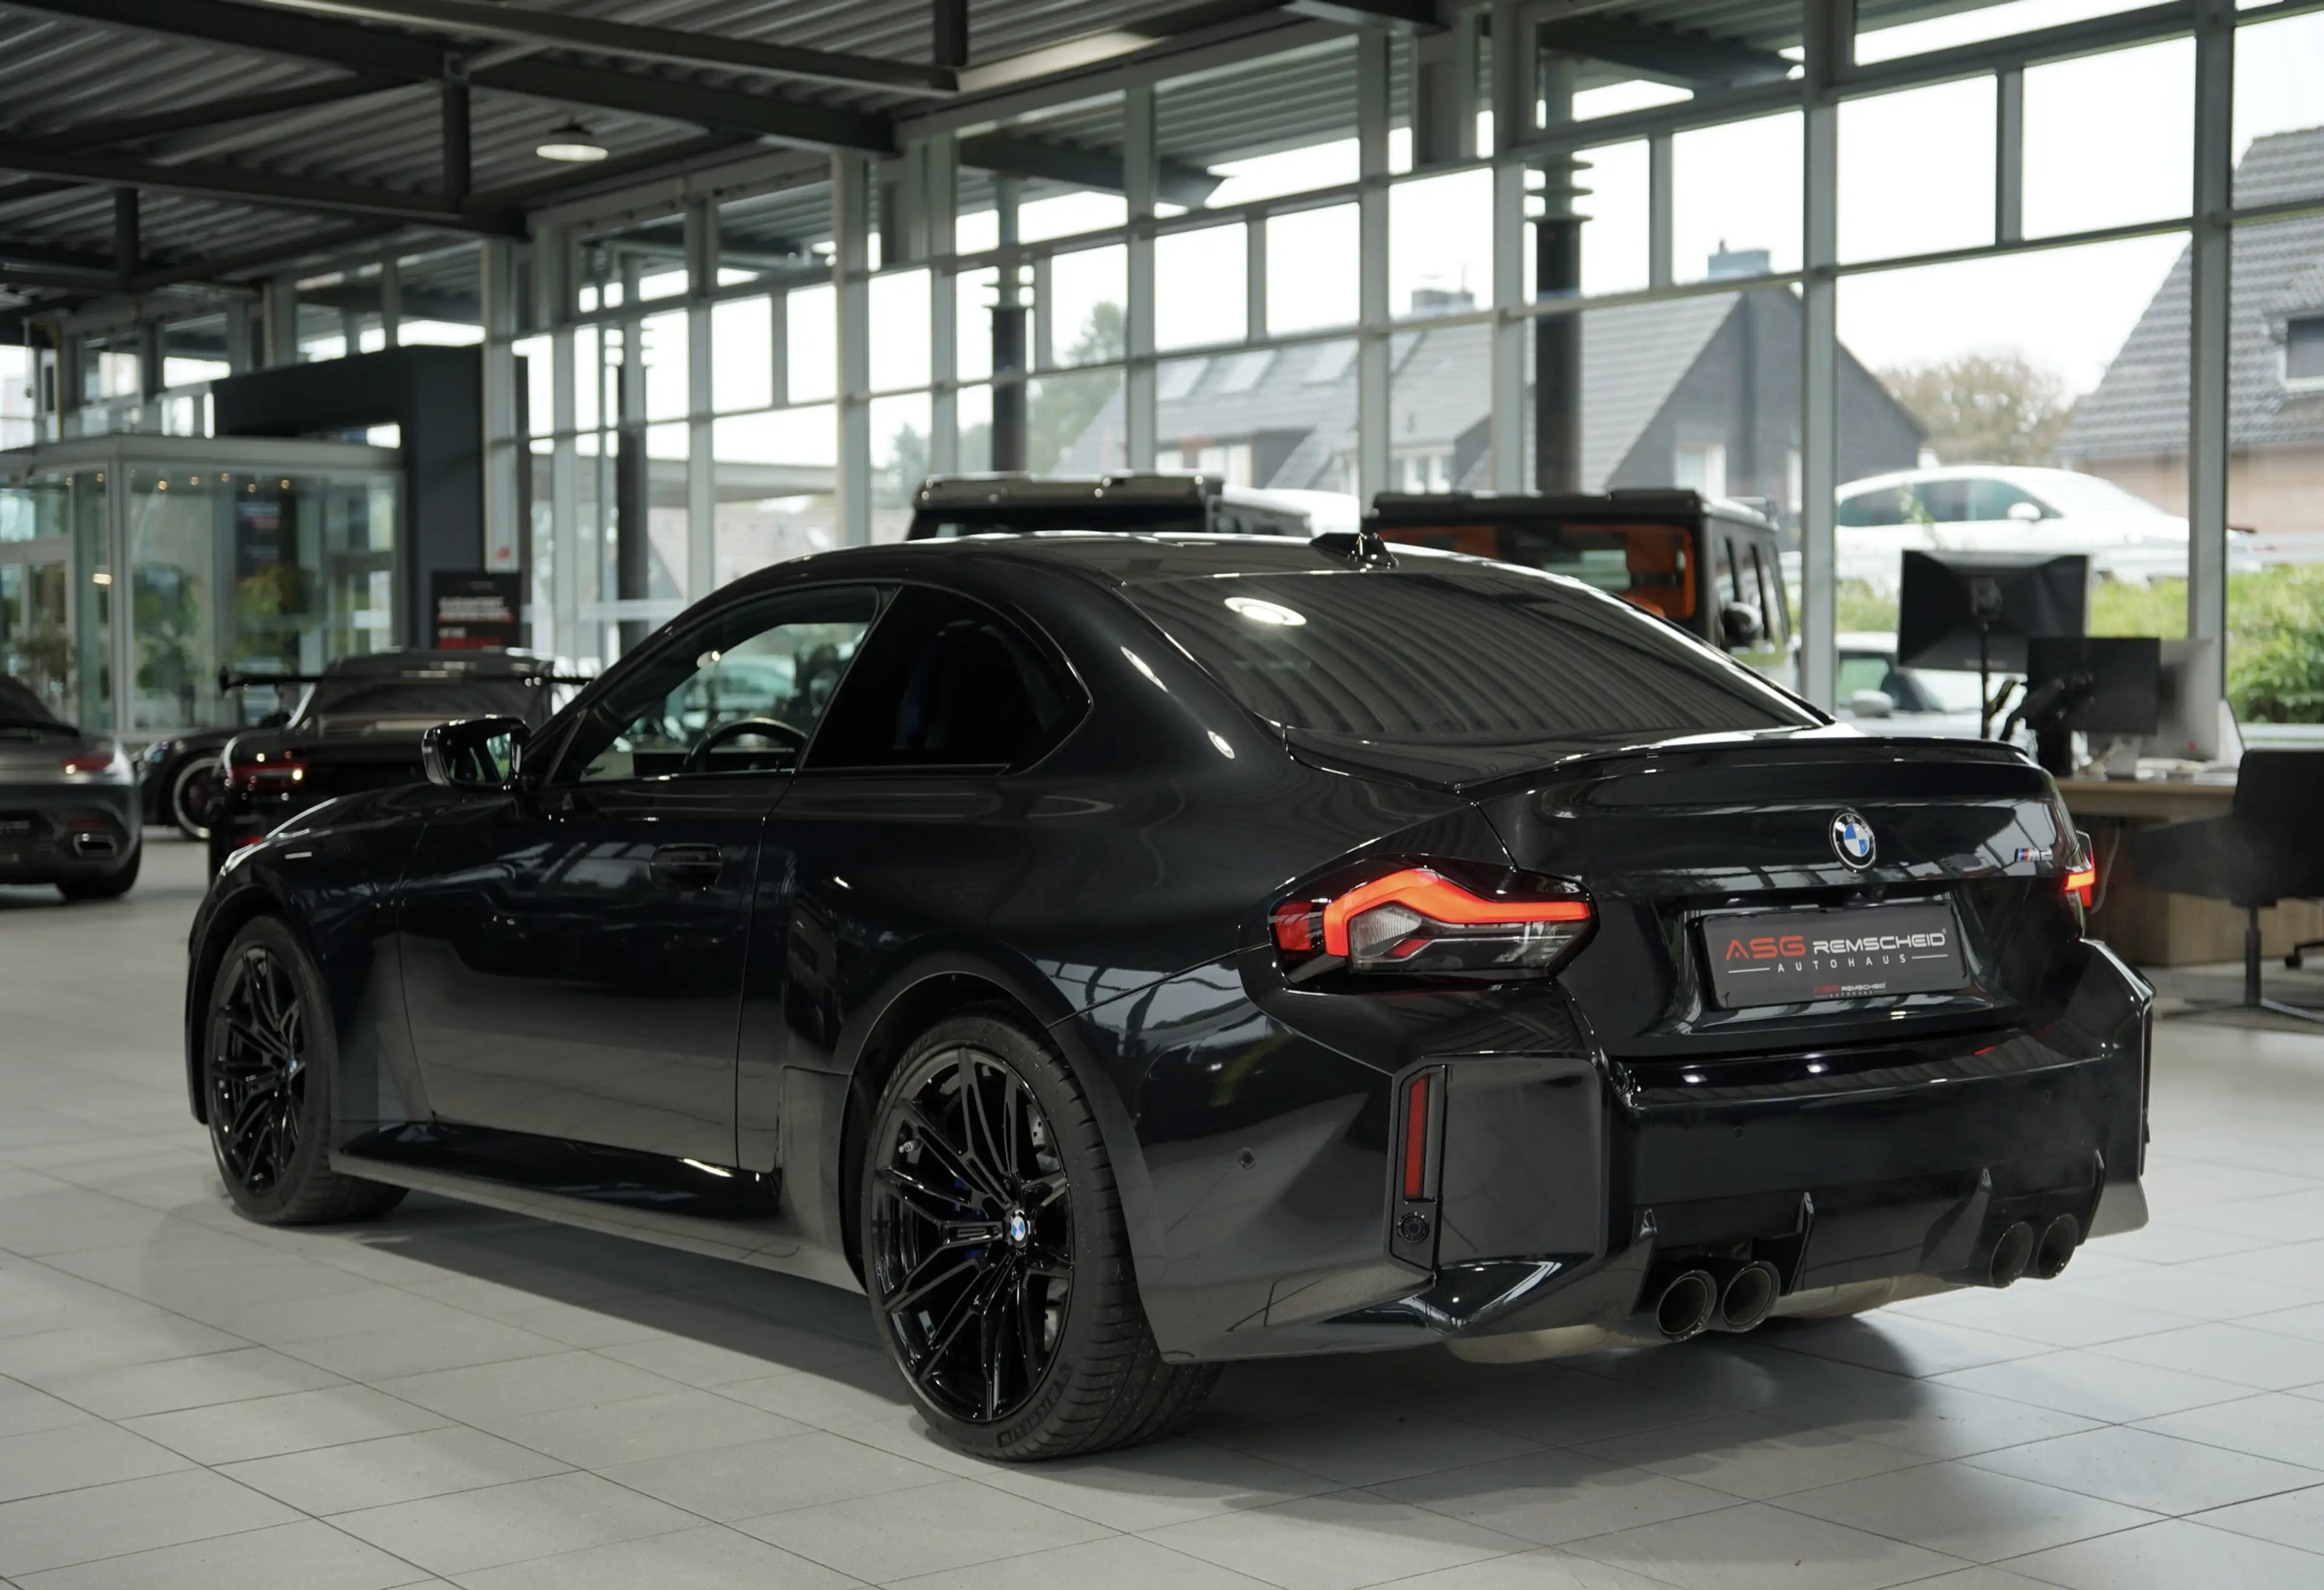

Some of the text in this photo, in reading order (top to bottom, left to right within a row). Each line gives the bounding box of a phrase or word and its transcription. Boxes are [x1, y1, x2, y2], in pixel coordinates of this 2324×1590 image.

[1725, 932, 1946, 961] ASG REMSCHEID
[1777, 954, 1906, 973] AUTOHAUS
